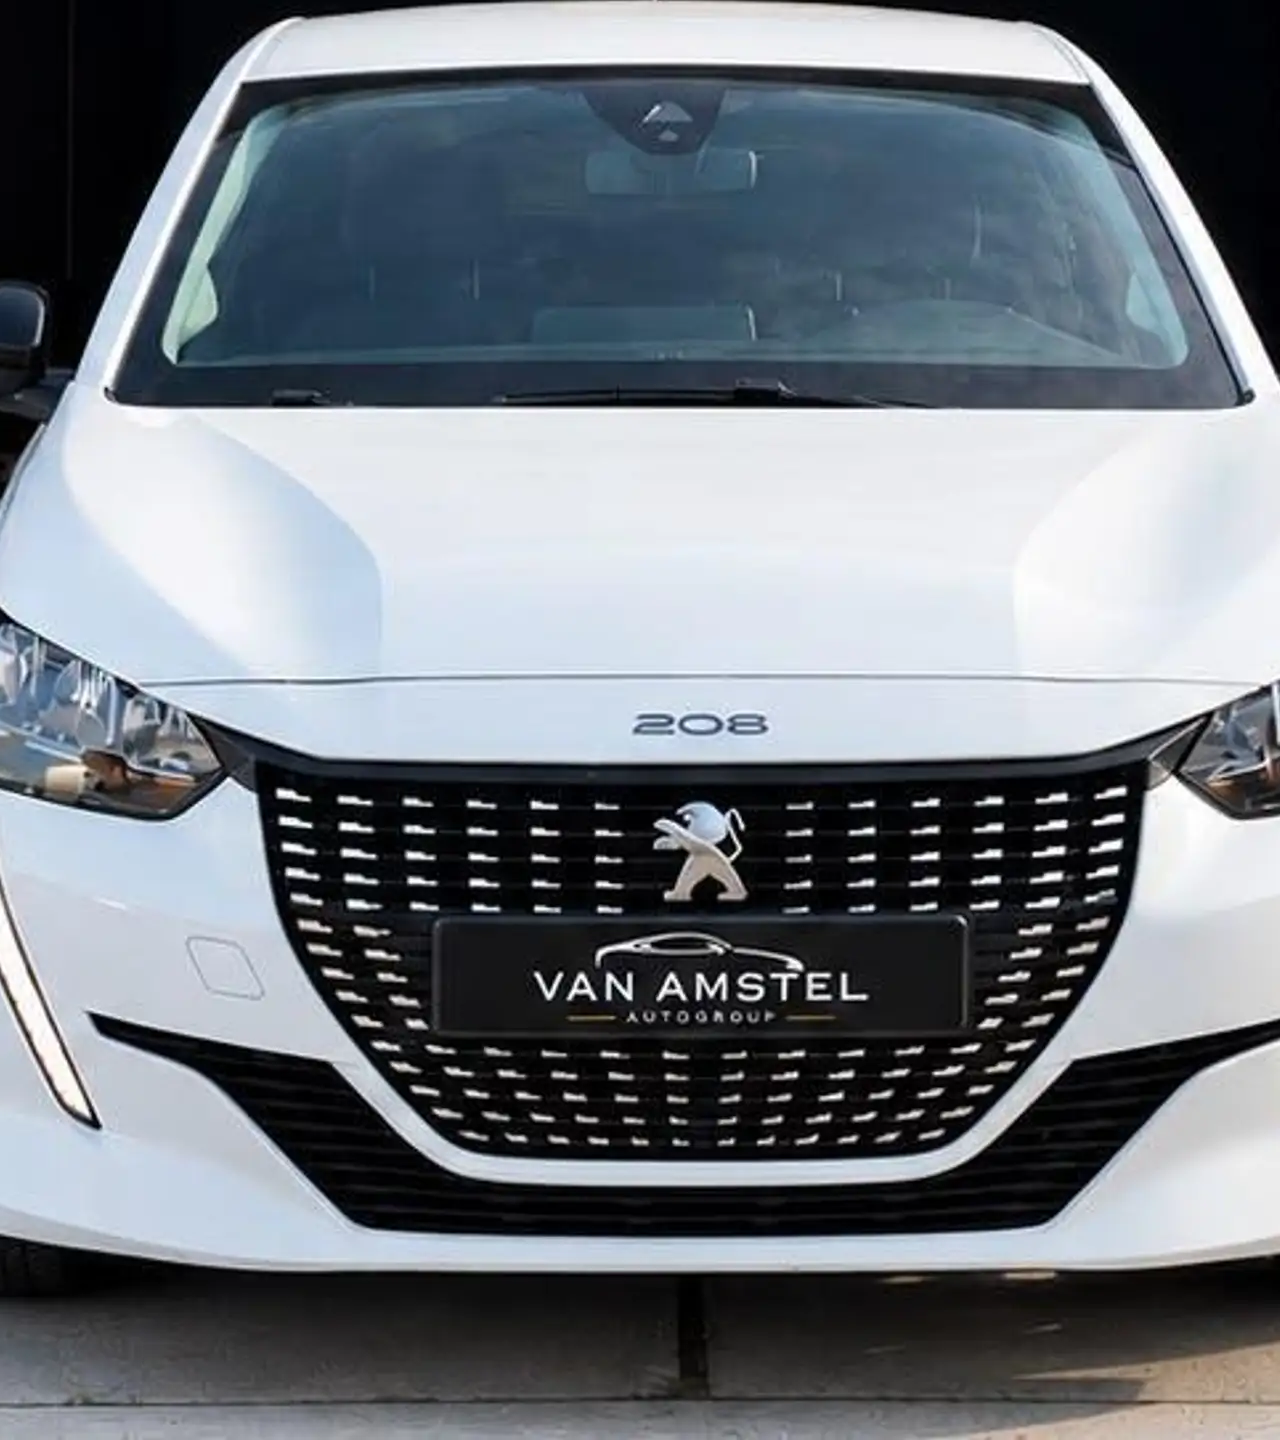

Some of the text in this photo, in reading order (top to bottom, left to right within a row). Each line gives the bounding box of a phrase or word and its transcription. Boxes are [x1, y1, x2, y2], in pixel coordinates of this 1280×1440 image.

[632, 713, 770, 737] 208
[533, 971, 869, 1002] VAN AMSTEL
[626, 1010, 776, 1024] AUTOGROUP
